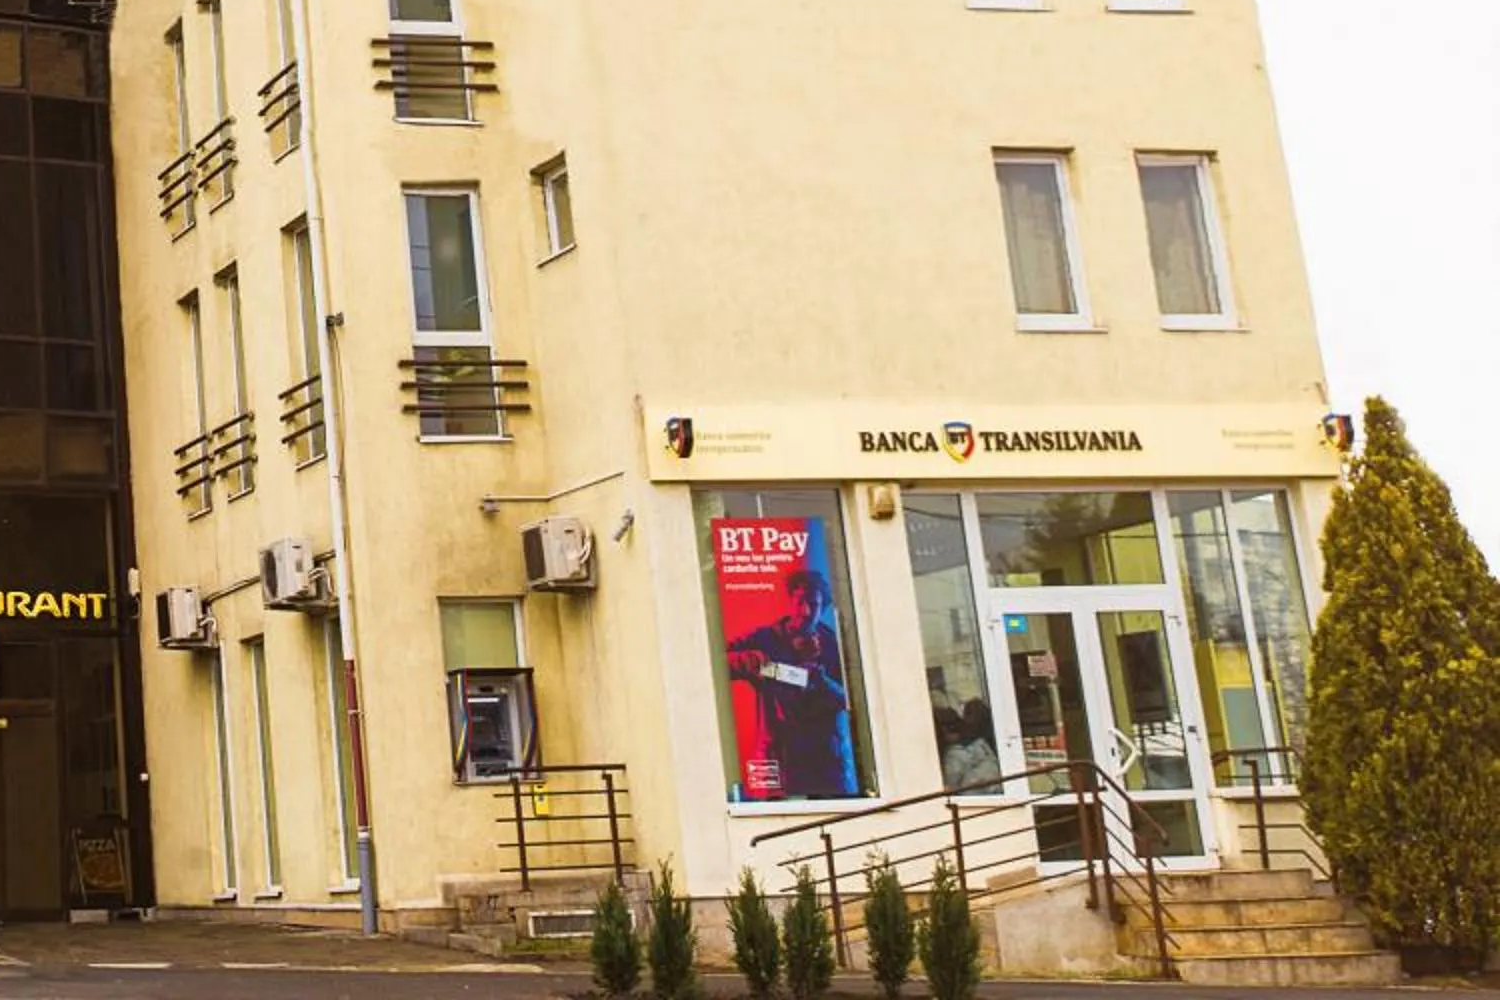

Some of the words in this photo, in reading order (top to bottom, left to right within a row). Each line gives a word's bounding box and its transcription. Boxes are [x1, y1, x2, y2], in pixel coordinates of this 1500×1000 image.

[858, 431, 939, 452] BANCA
[978, 430, 1143, 452] TRANSILVANIA
[719, 527, 754, 552] BT
[761, 527, 809, 557] Pay
